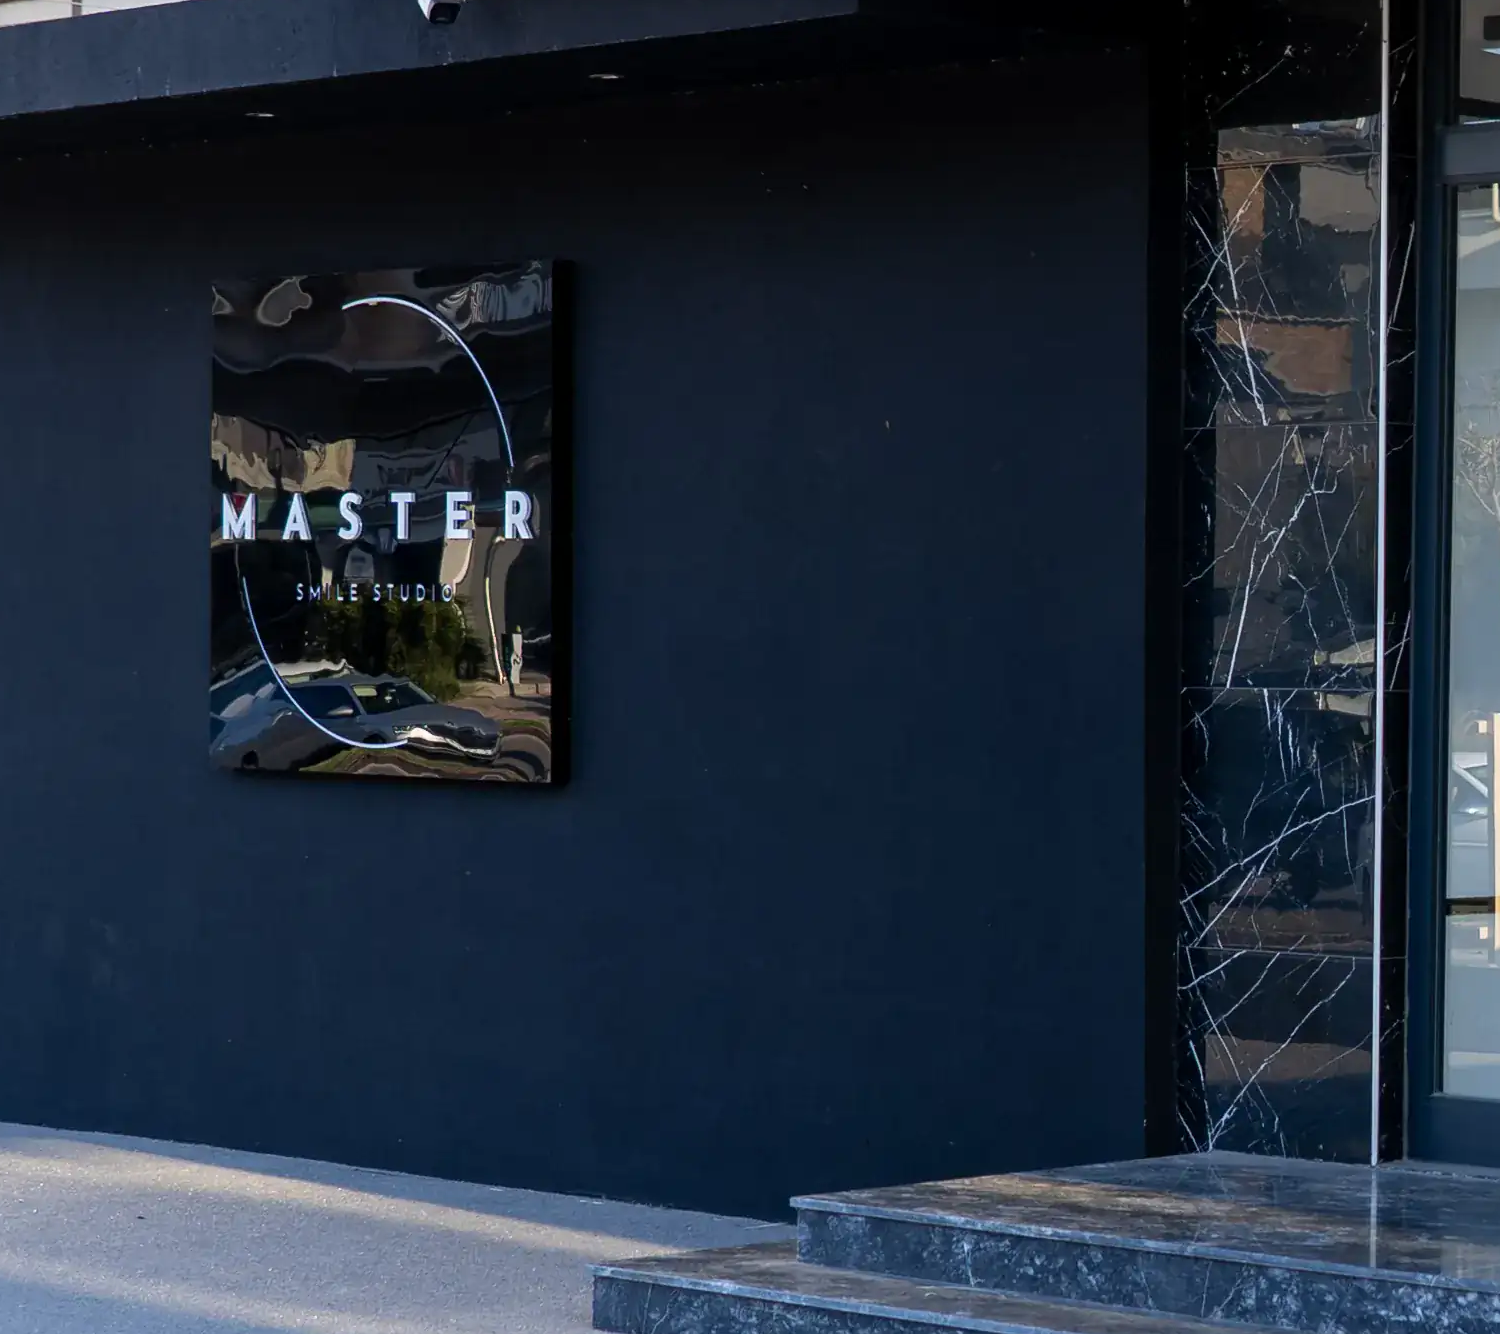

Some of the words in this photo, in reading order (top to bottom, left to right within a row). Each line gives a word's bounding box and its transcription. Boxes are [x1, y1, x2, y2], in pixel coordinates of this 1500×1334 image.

[221, 490, 536, 541] MASTER
[296, 582, 358, 603] SMILE
[372, 582, 455, 603] STUDIO
